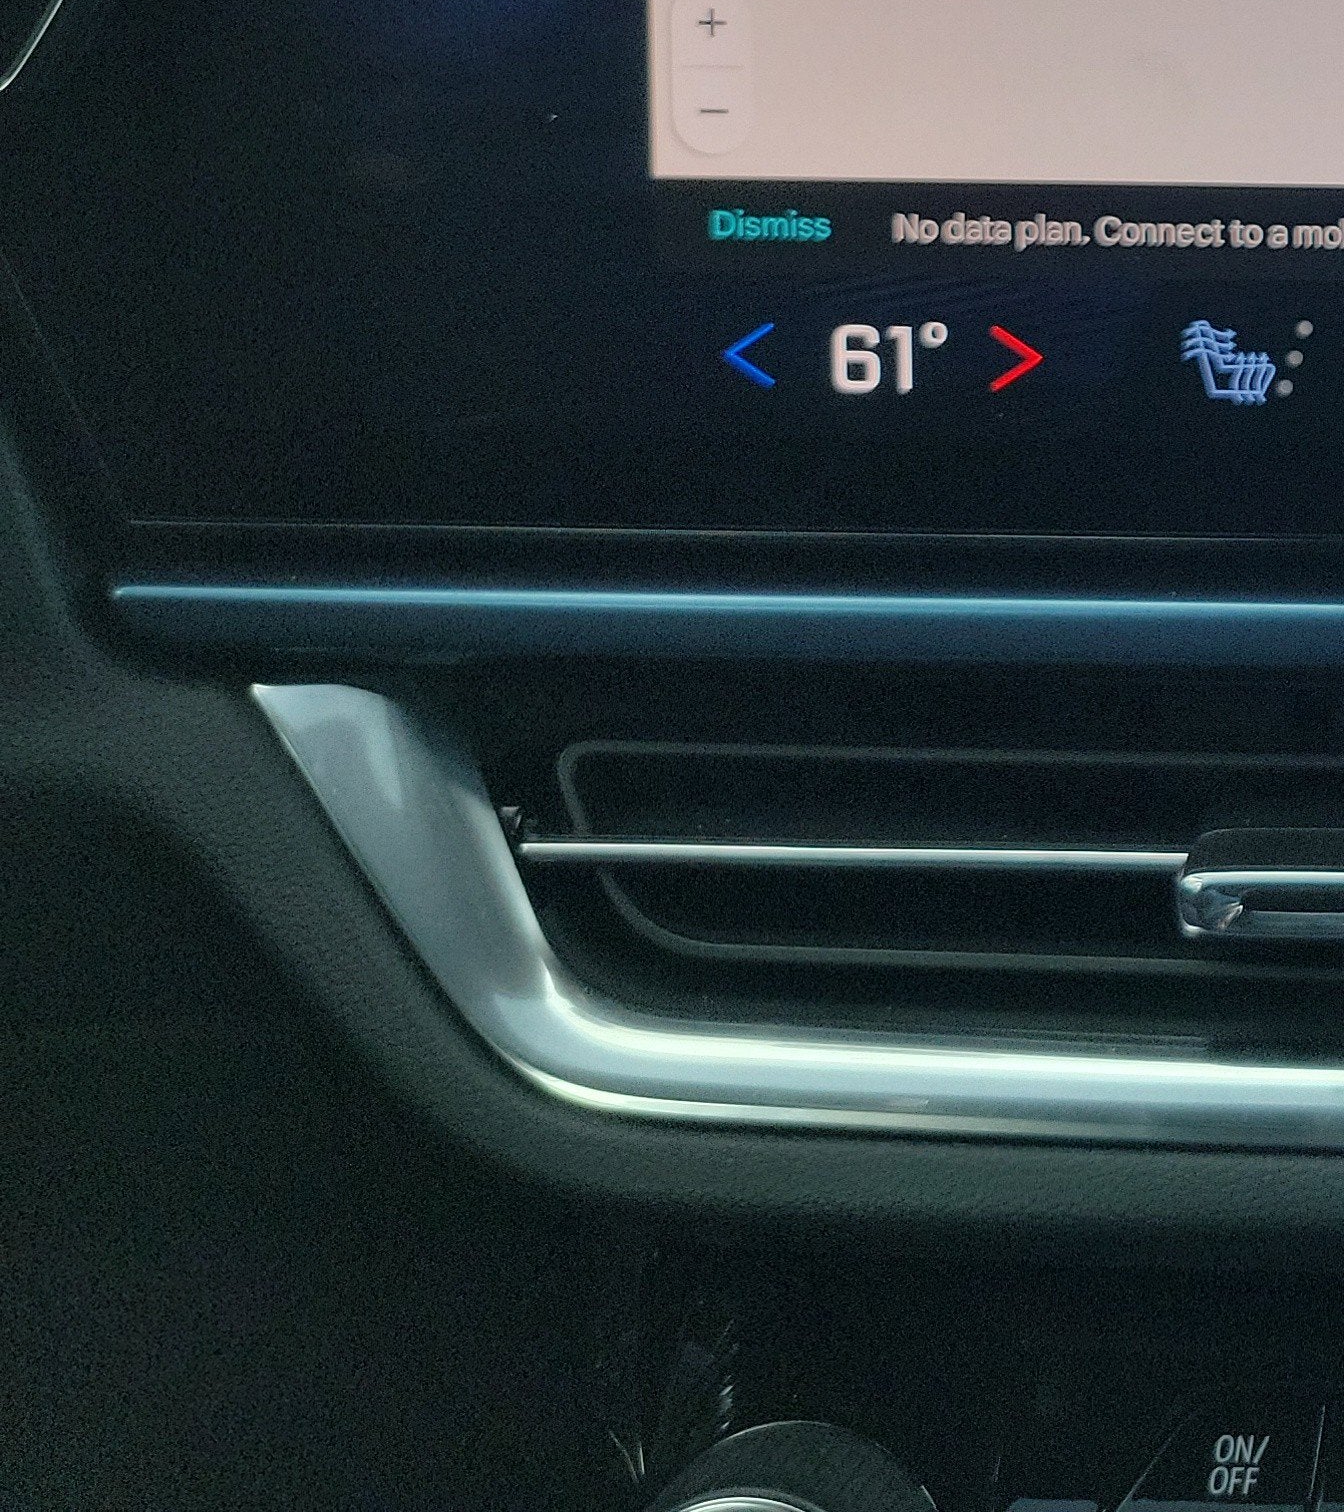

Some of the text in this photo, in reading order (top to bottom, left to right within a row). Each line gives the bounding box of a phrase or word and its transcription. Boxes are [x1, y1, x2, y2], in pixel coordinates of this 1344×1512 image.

[708, 208, 832, 243] Dismiss
[892, 212, 939, 245] No
[940, 211, 1012, 246] data
[1013, 213, 1091, 253] plan.
[1094, 215, 1226, 249] Connect
[1229, 219, 1264, 249] to
[1267, 224, 1289, 250] a
[829, 319, 950, 396] 61°
[1213, 1434, 1270, 1464] ON/
[1207, 1465, 1260, 1497] OFF
